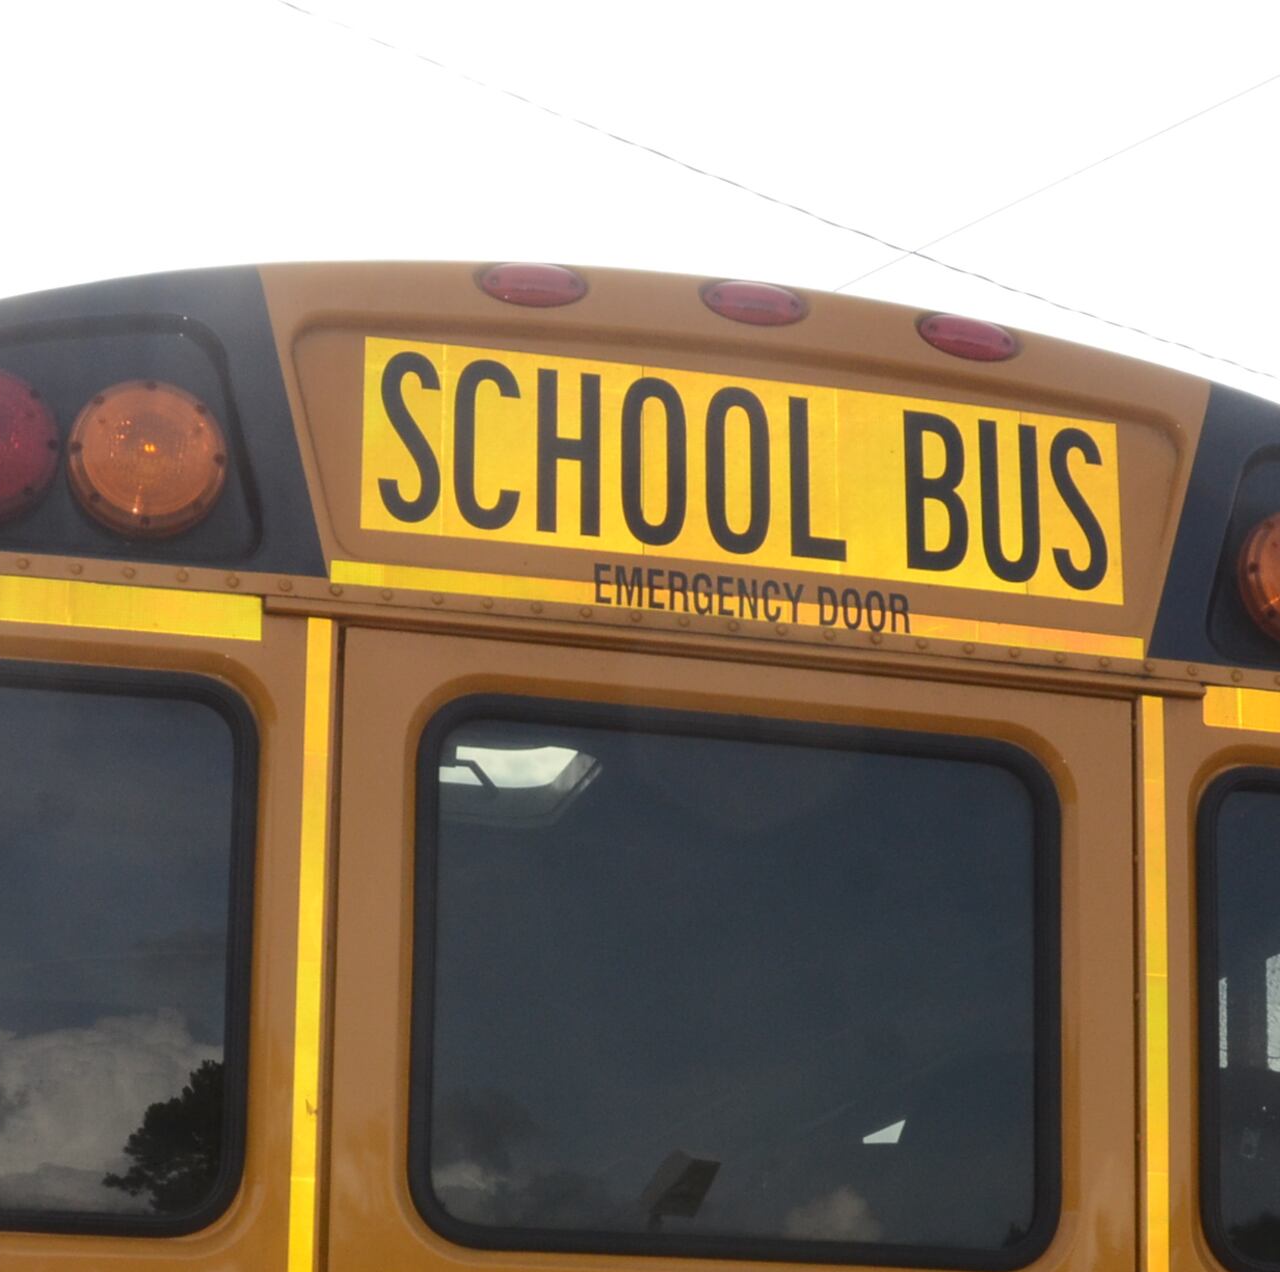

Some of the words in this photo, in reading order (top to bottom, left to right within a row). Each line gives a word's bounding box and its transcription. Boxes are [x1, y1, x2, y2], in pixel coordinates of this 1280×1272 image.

[377, 350, 847, 563] SCHOOL
[902, 408, 1109, 591] BUS
[593, 562, 807, 624] EMERGENCY
[818, 587, 911, 634] DOOR
